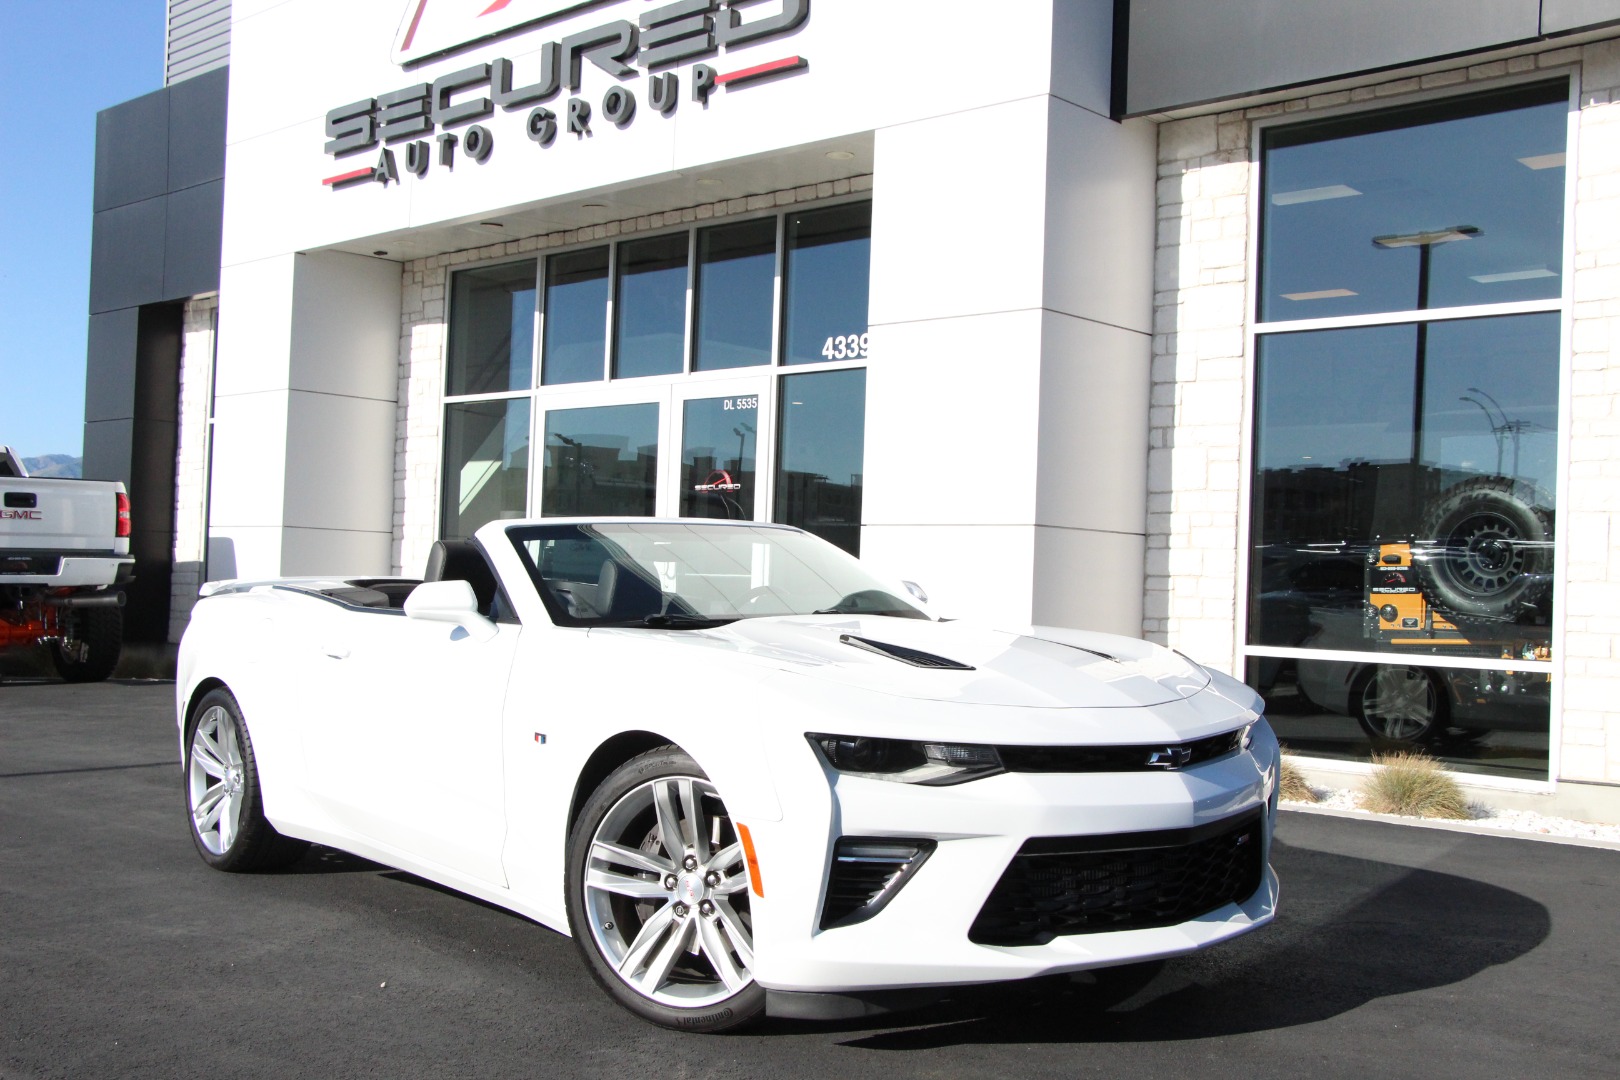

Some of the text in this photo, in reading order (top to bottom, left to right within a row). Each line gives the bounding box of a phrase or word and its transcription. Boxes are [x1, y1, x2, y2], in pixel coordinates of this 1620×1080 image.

[323, 0, 812, 156] SECURED
[374, 64, 717, 186] AUTO GROUP
[821, 333, 869, 359] 4339
[723, 397, 758, 411] DL 5535
[694, 483, 741, 491] SECURED
[0, 510, 42, 520] GMC
[681, 1007, 734, 1025] Continental
